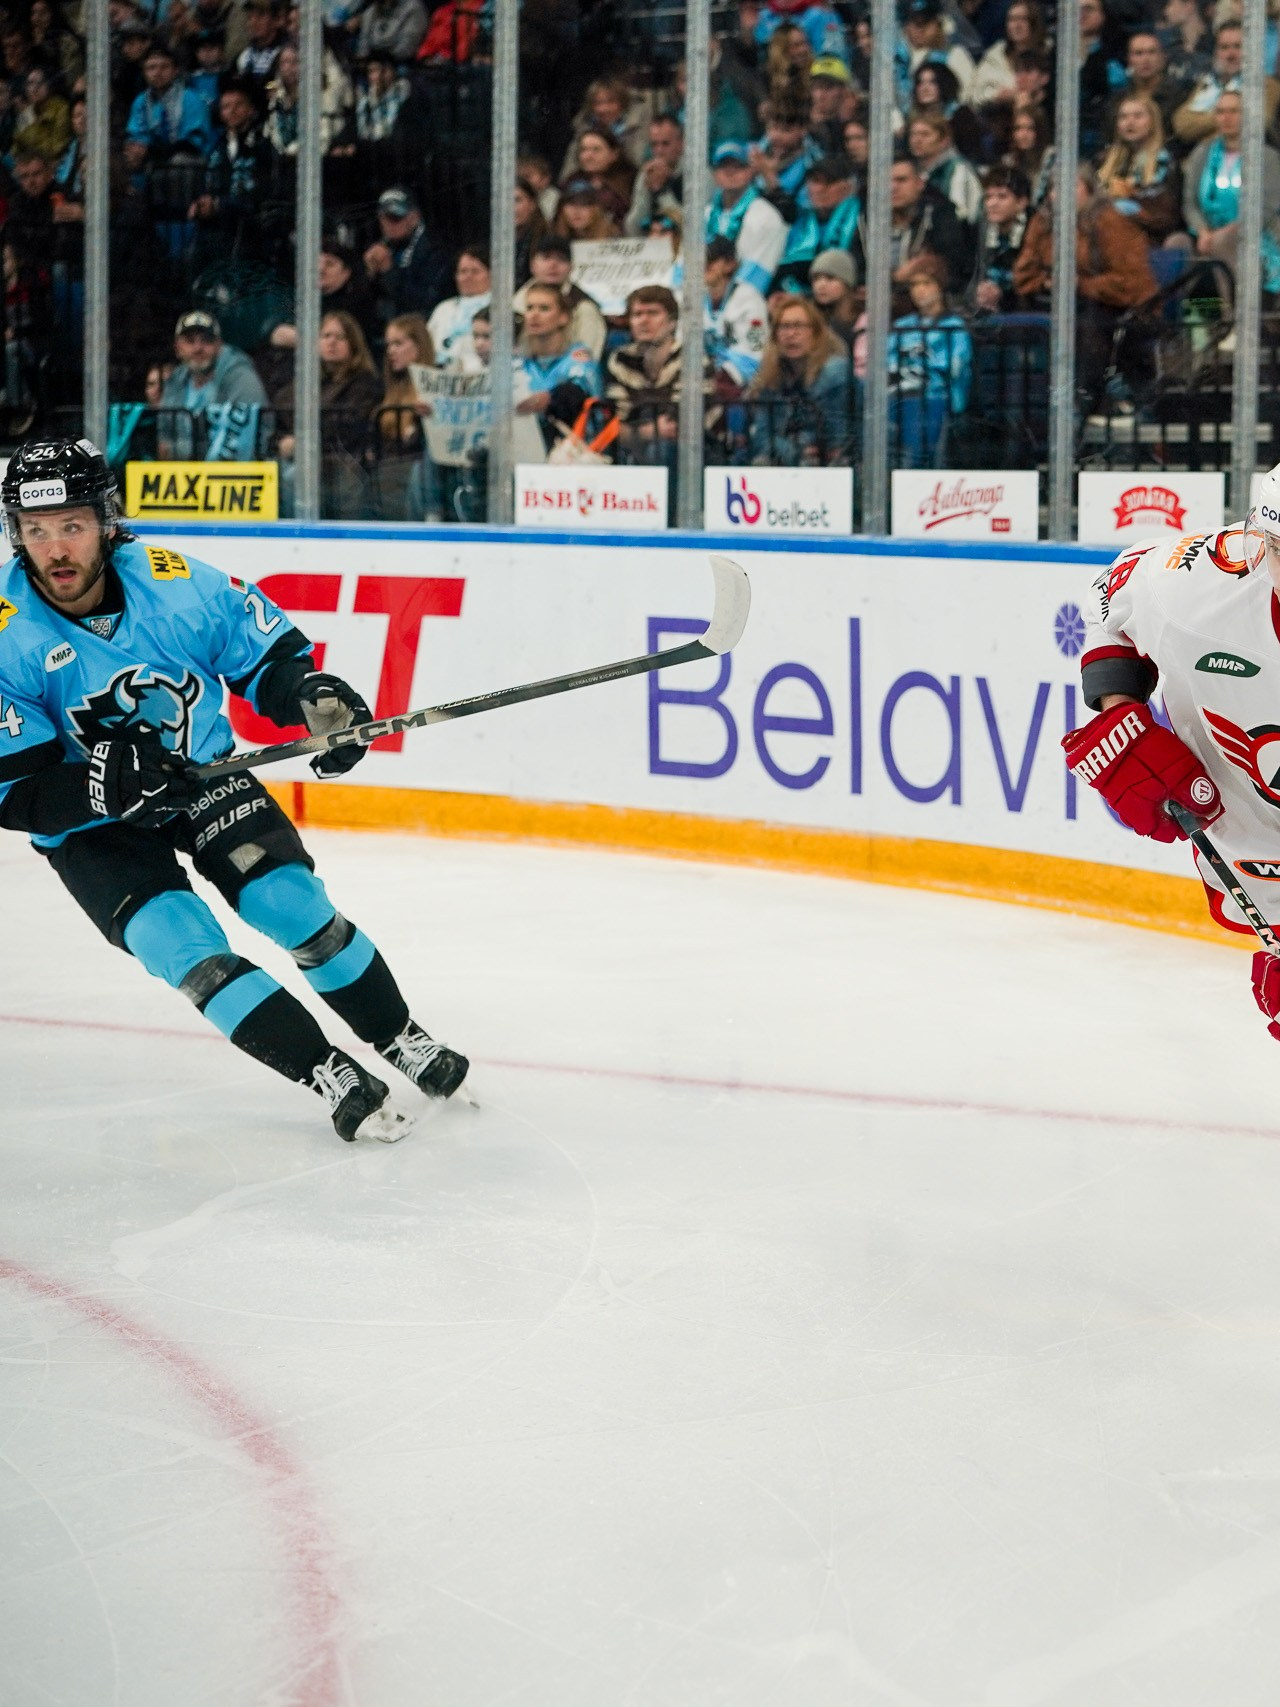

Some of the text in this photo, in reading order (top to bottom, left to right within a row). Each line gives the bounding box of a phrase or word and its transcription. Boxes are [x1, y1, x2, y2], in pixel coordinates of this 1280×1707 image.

[30, 447, 56, 460] 24
[22, 486, 64, 500] согаз
[523, 490, 659, 512] BSB Bank
[767, 502, 830, 527] belbet
[150, 549, 170, 573] MAX
[244, 594, 281, 635] 2
[1207, 657, 1246, 671] МИР
[648, 602, 1174, 831] Belavi
[327, 712, 427, 748] CCM
[188, 776, 251, 820] Belavia
